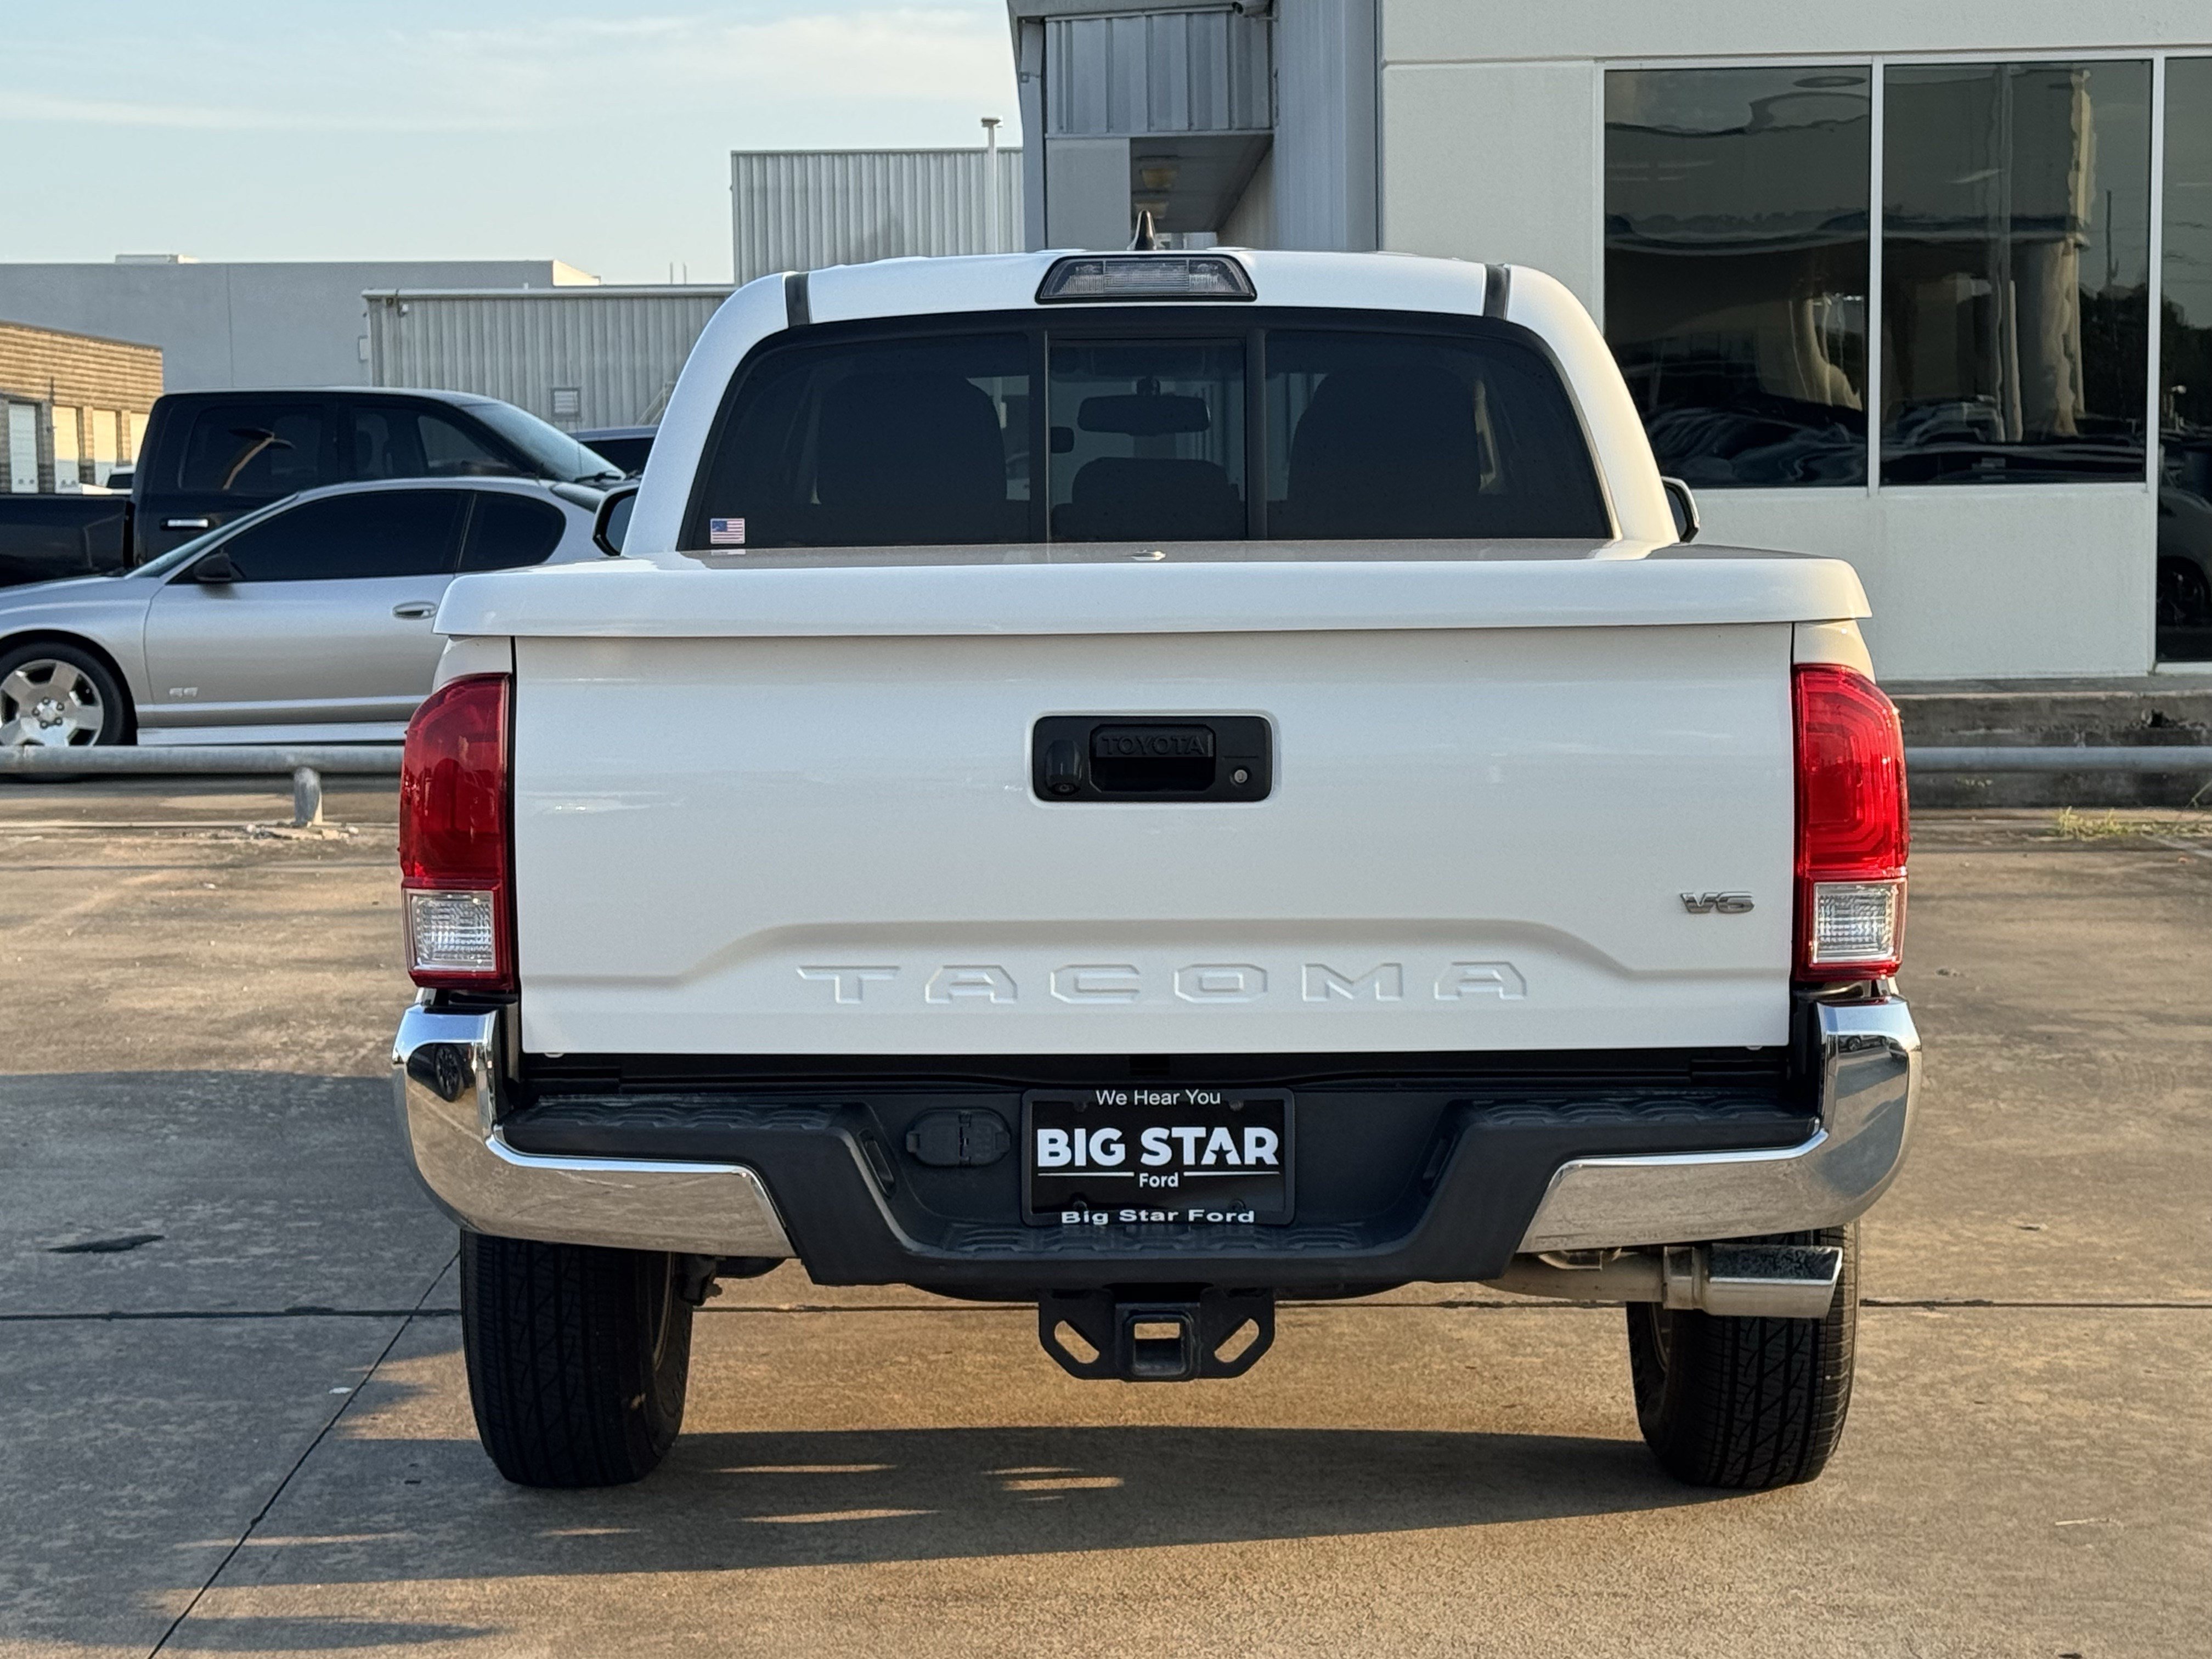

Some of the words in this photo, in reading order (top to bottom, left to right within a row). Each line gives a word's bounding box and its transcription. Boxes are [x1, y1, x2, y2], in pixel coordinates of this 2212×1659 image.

[1102, 735, 1205, 755] TOYOTA
[1679, 891, 1755, 914] V6
[797, 961, 1527, 1003] TACOMA
[1096, 1090, 1127, 1105] We
[1134, 1090, 1180, 1105] Hear
[1186, 1089, 1221, 1104] You
[1037, 1127, 1126, 1167] BIG
[1140, 1127, 1279, 1166] STAR
[1139, 1172, 1179, 1188] Ford
[1061, 1211, 1109, 1225] Big
[1119, 1209, 1179, 1222] Star
[1188, 1209, 1255, 1223] Ford
